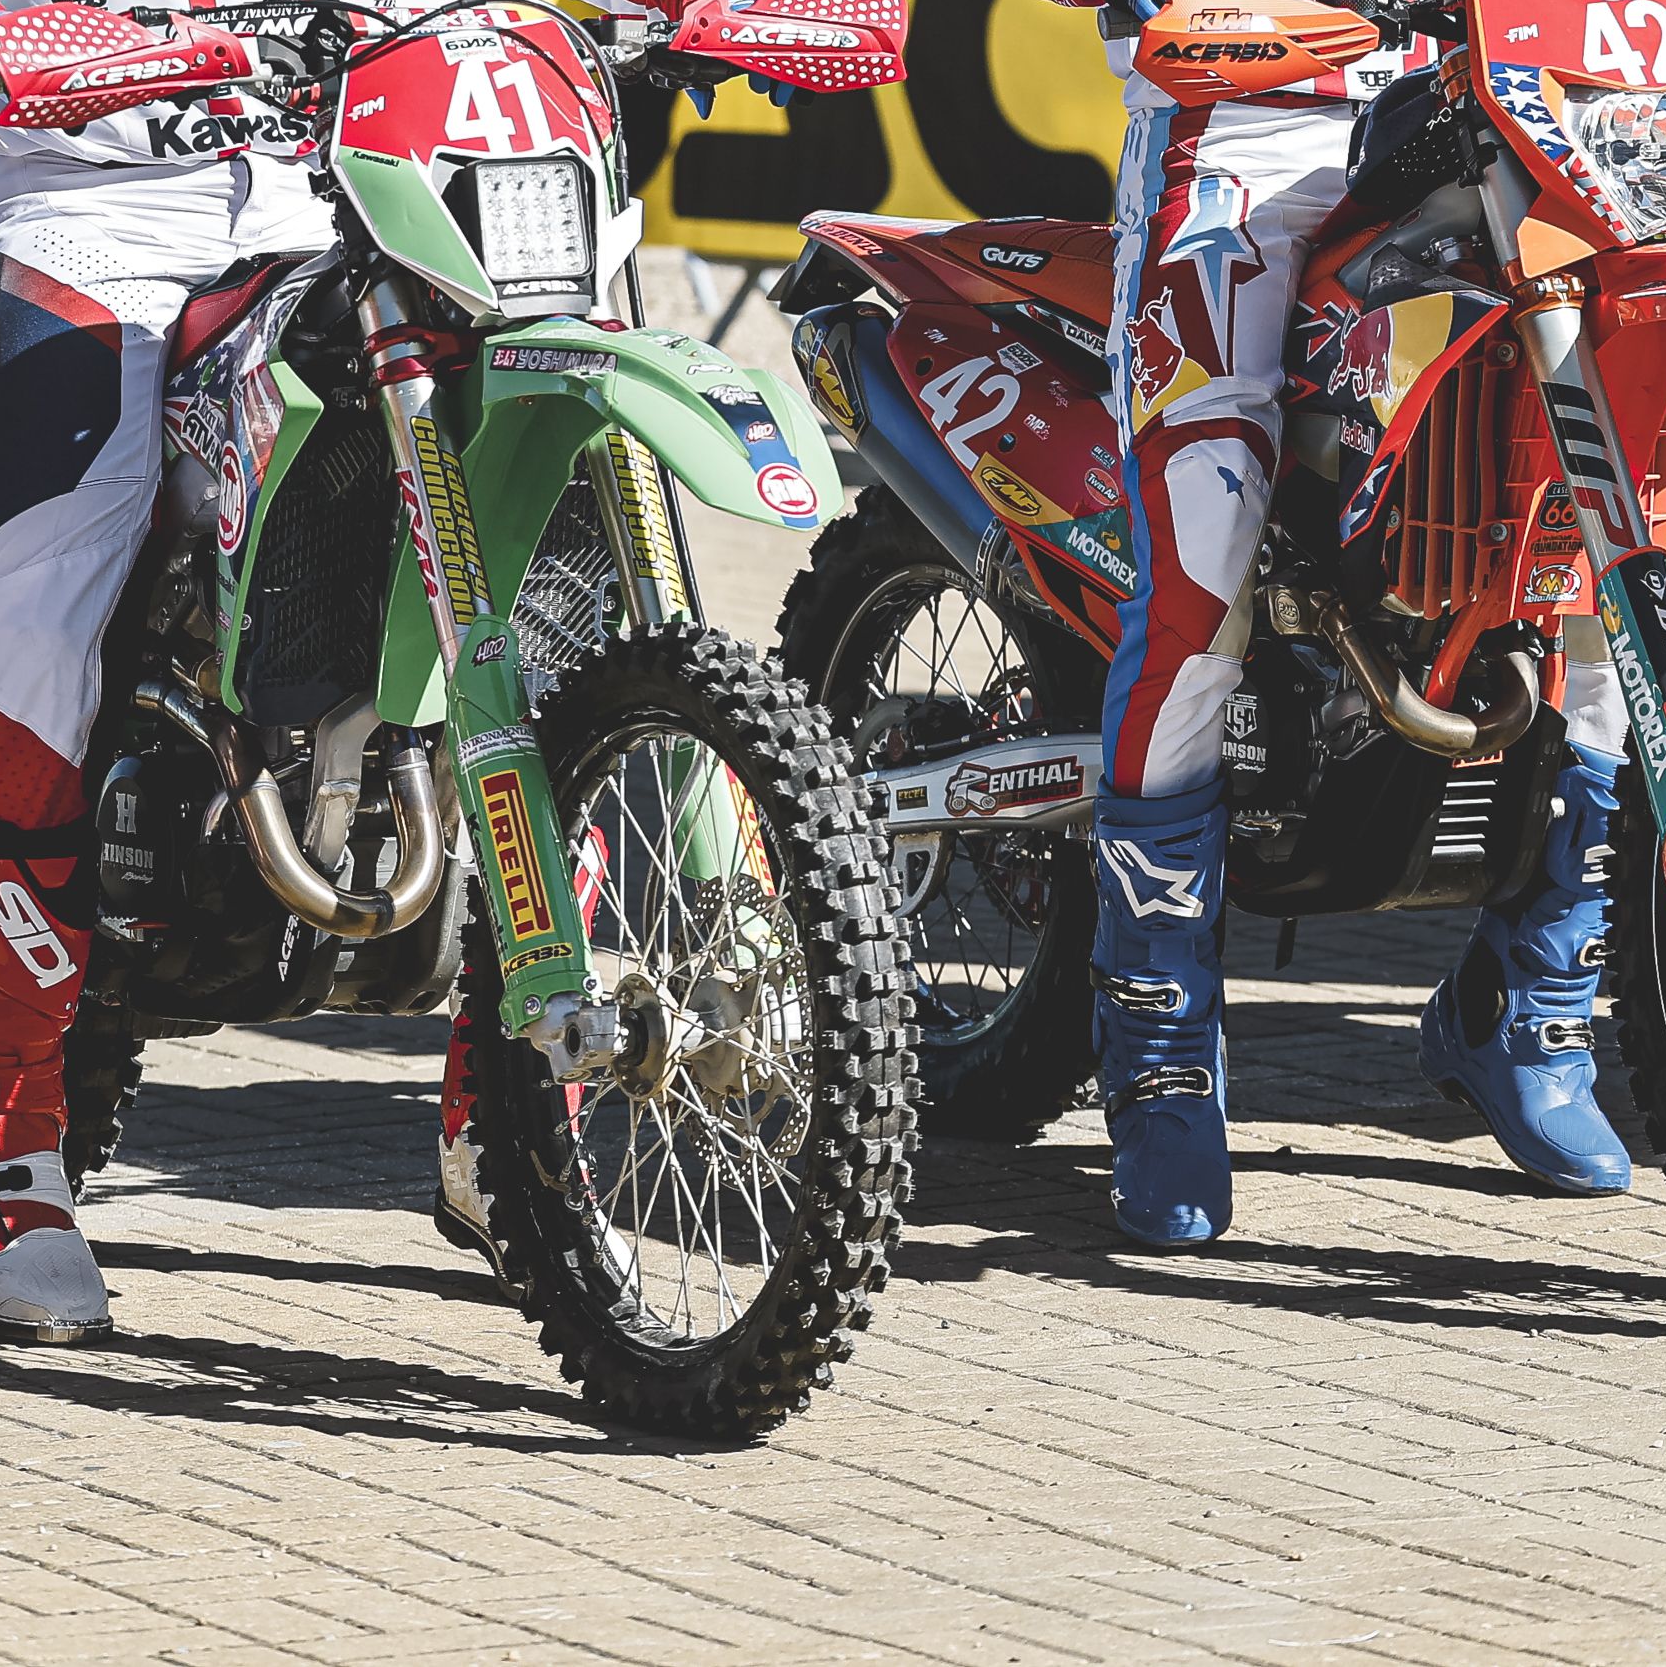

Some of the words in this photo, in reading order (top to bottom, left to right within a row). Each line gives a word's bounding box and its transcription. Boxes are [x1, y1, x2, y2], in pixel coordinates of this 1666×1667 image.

[1190, 9, 1252, 32] KTM
[730, 26, 861, 49] ACERBIS
[1505, 24, 1539, 43] FIM
[1152, 42, 1289, 63] ACERBIS
[60, 58, 189, 91] ACERBIS
[347, 95, 385, 121] FIM
[444, 59, 553, 156] 41
[149, 112, 311, 160] Kawas
[352, 149, 401, 168] Kawasaki
[983, 247, 1044, 271] GUTS
[502, 279, 580, 296] ACERBIS
[515, 348, 618, 373] YOSHIMURA
[919, 356, 1021, 472] 42
[1087, 472, 1106, 493] Twin
[1102, 486, 1118, 501] Air
[411, 416, 476, 626] Connection
[1545, 504, 1576, 524] 66
[1066, 525, 1137, 590] MOTOREX
[483, 770, 551, 936] PIRELLI
